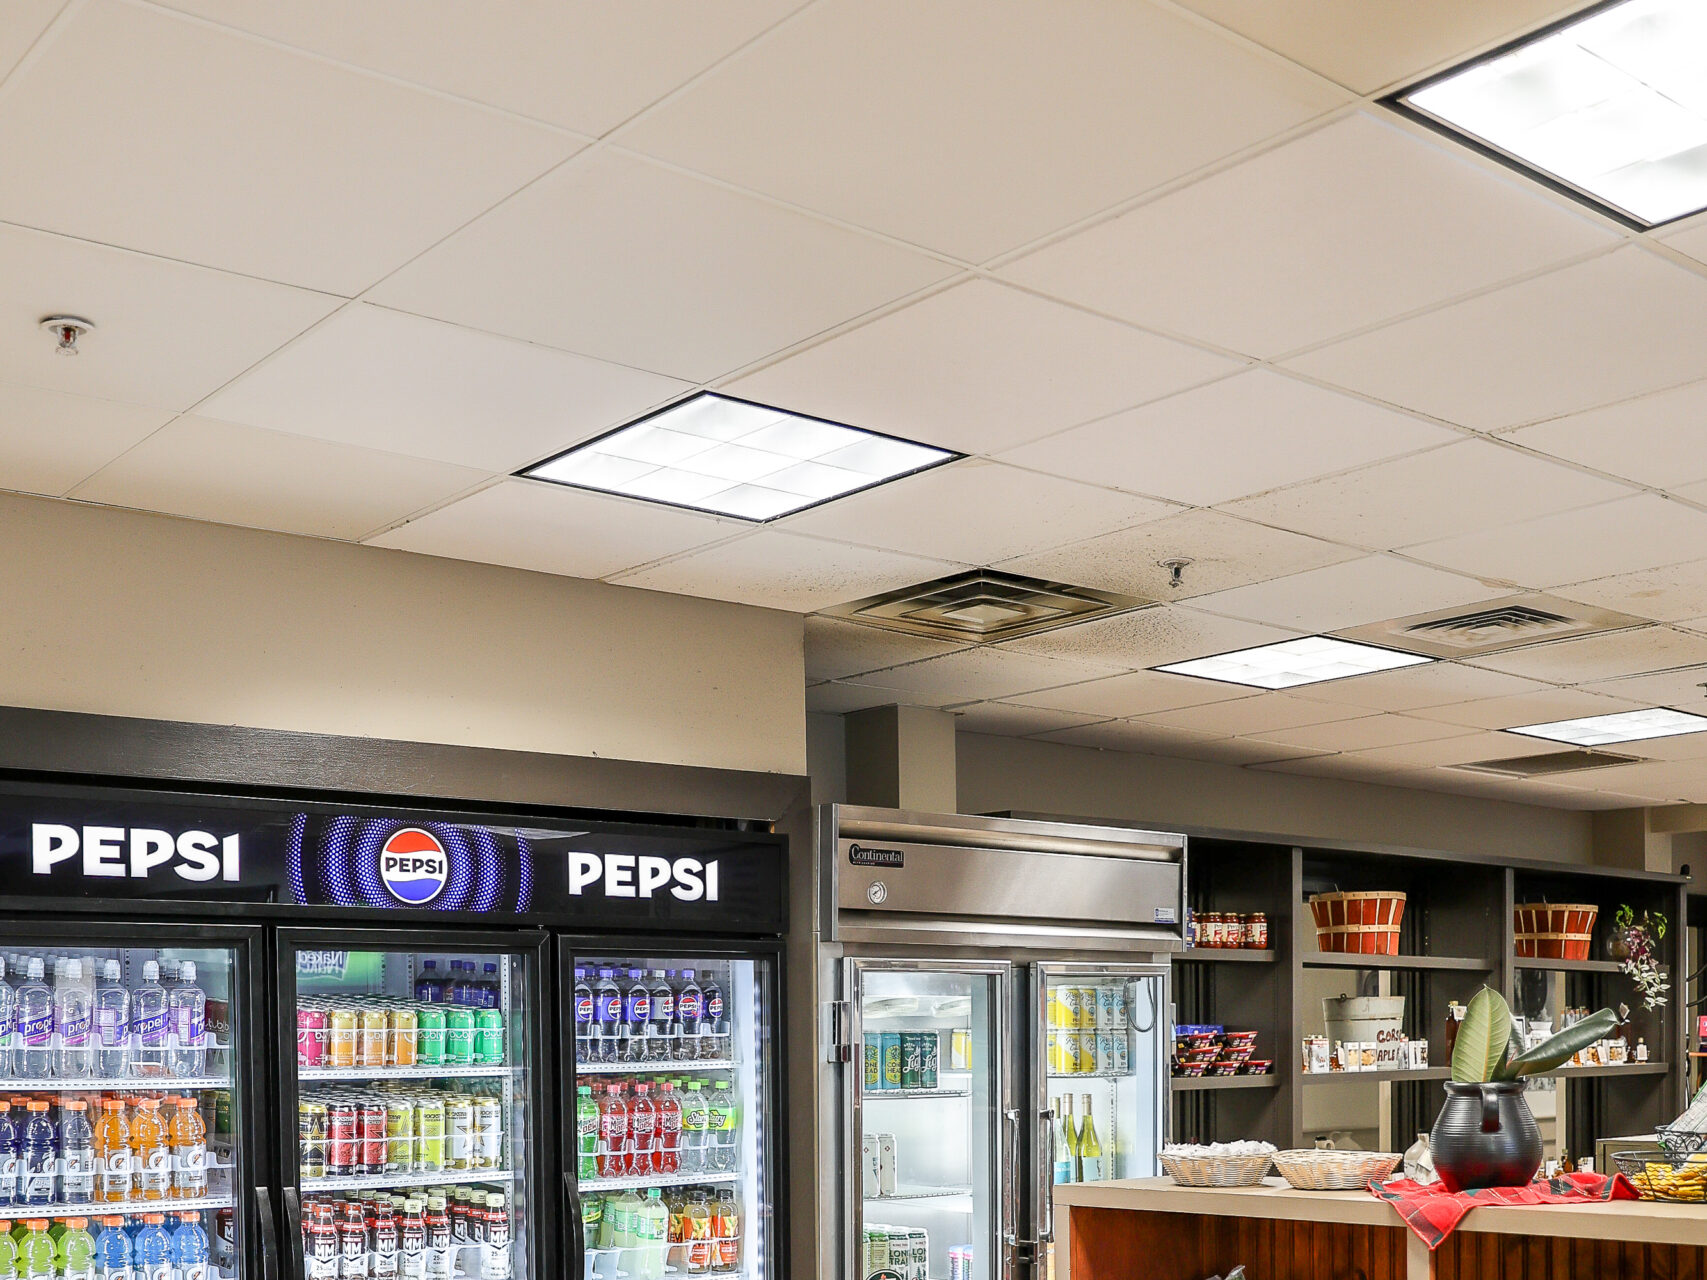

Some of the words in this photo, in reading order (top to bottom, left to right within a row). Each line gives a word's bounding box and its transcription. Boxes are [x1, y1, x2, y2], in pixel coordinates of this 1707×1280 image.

[32, 823, 240, 882] PEPSI
[384, 856, 444, 876] PEPSI
[852, 845, 903, 862] Continental
[568, 851, 718, 902] PEPSI
